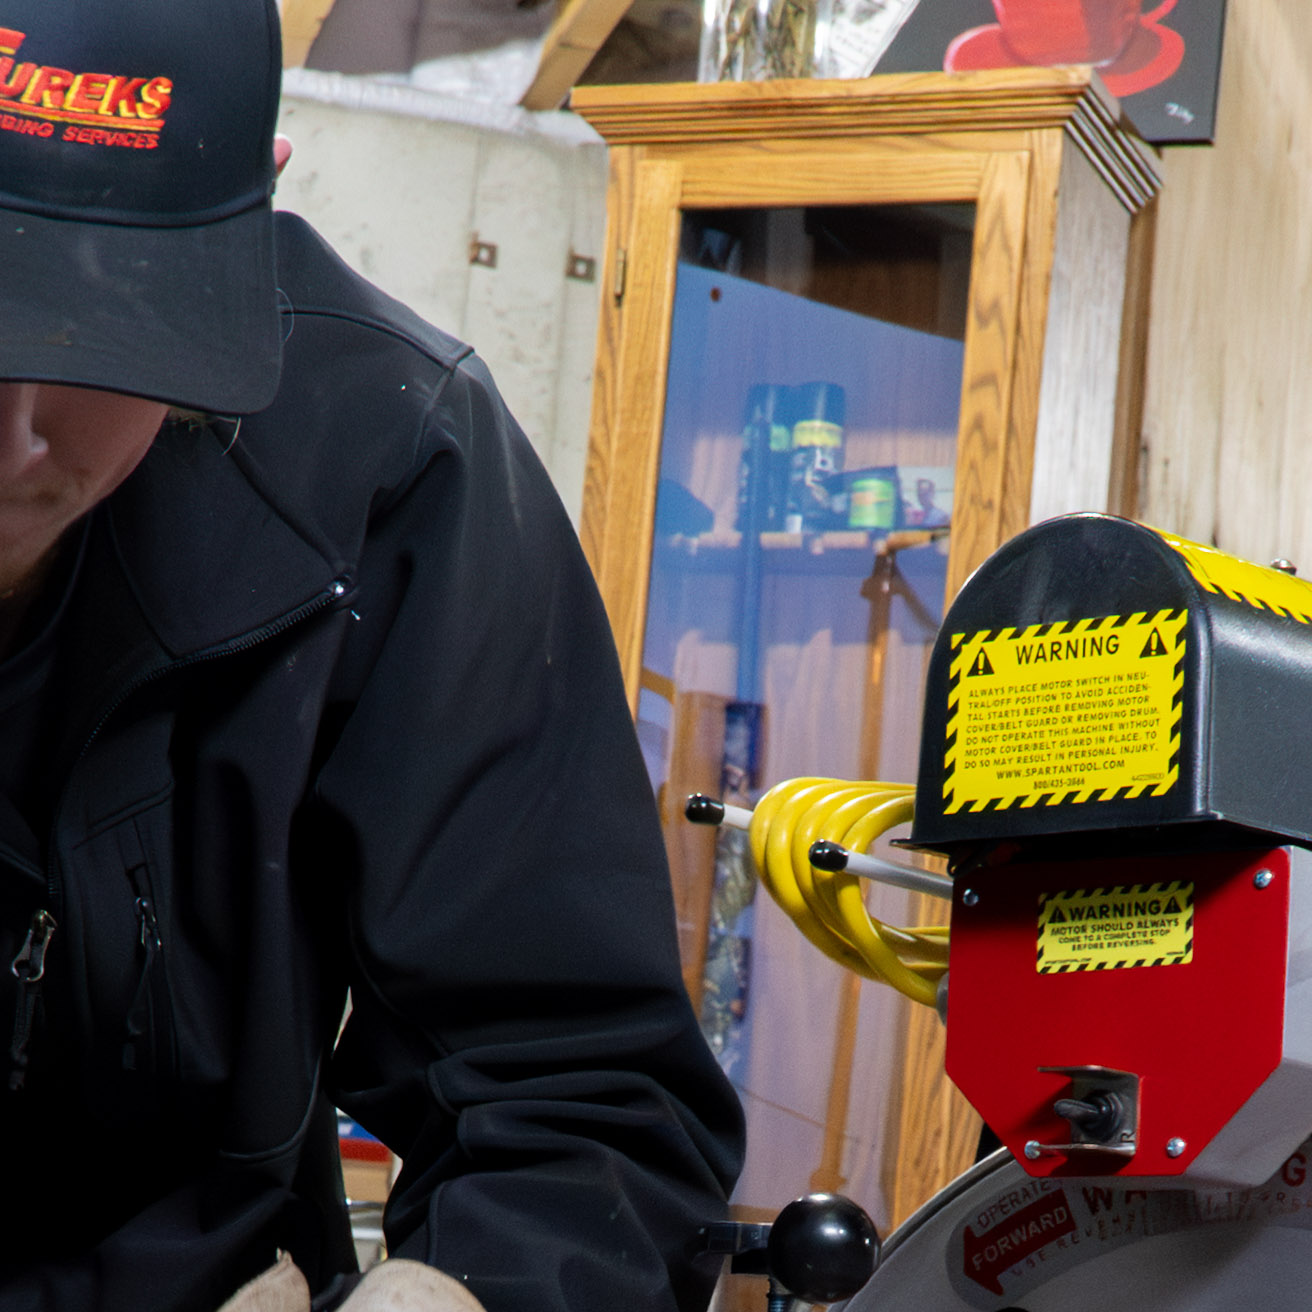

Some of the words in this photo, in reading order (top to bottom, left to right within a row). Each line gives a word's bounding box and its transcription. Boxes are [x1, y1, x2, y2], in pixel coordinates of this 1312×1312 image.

[62, 126, 161, 149] SERVICES
[1015, 634, 1120, 666] WARNING
[969, 687, 1005, 698] ALWAYS
[1008, 683, 1038, 694] PLACE
[1040, 680, 1073, 691] MOTOR
[1076, 676, 1110, 686] SWITCH
[1113, 674, 1123, 682] IN
[1126, 671, 1149, 680] NEU-
[1015, 694, 1057, 705] POSITION
[1061, 692, 1072, 700] TO
[1075, 688, 1104, 698] AVOID
[1107, 683, 1150, 695] ACCIDEN-
[968, 713, 984, 721] TAL
[988, 708, 1020, 720] STARTS
[1023, 704, 1061, 716] BEFORE
[1064, 699, 1114, 711] REMOVING
[1117, 695, 1149, 706] MOTOR
[1026, 717, 1058, 728] GUARD
[1061, 715, 1073, 724] OR
[1077, 710, 1127, 722] REMOVING
[965, 747, 997, 757] MOTOR
[1060, 737, 1092, 748] GUARD
[1095, 736, 1105, 745] IN
[1145, 731, 1157, 740] TO
[966, 737, 978, 746] DO
[981, 735, 999, 744] NOT
[1002, 730, 1045, 742] OPERATE
[1048, 727, 1069, 737] THIS
[1072, 723, 1114, 734] MACHINE
[1118, 718, 1160, 730] WITHOUT
[964, 761, 977, 769] DO
[979, 759, 990, 768] SO
[993, 758, 1013, 766] MAY
[1016, 753, 1052, 764] RESULT
[1055, 752, 1065, 760] IN
[1068, 748, 1117, 760] PERSONAL
[1120, 743, 1158, 754] INJURY.
[1069, 900, 1161, 921] WARNING
[1051, 925, 1088, 936] MOTOR
[1090, 921, 1134, 934] SHOULD
[1136, 917, 1180, 929] ALWAYS
[1058, 934, 1081, 944] COME
[1083, 933, 1094, 942] TO
[1096, 933, 1102, 941] A
[1103, 930, 1148, 941] COMPLETE
[1150, 928, 1170, 938] STOP
[1071, 942, 1104, 952] BEFORE
[978, 1179, 1050, 1229] OPERATE
[971, 1205, 1068, 1271] FORWARD
